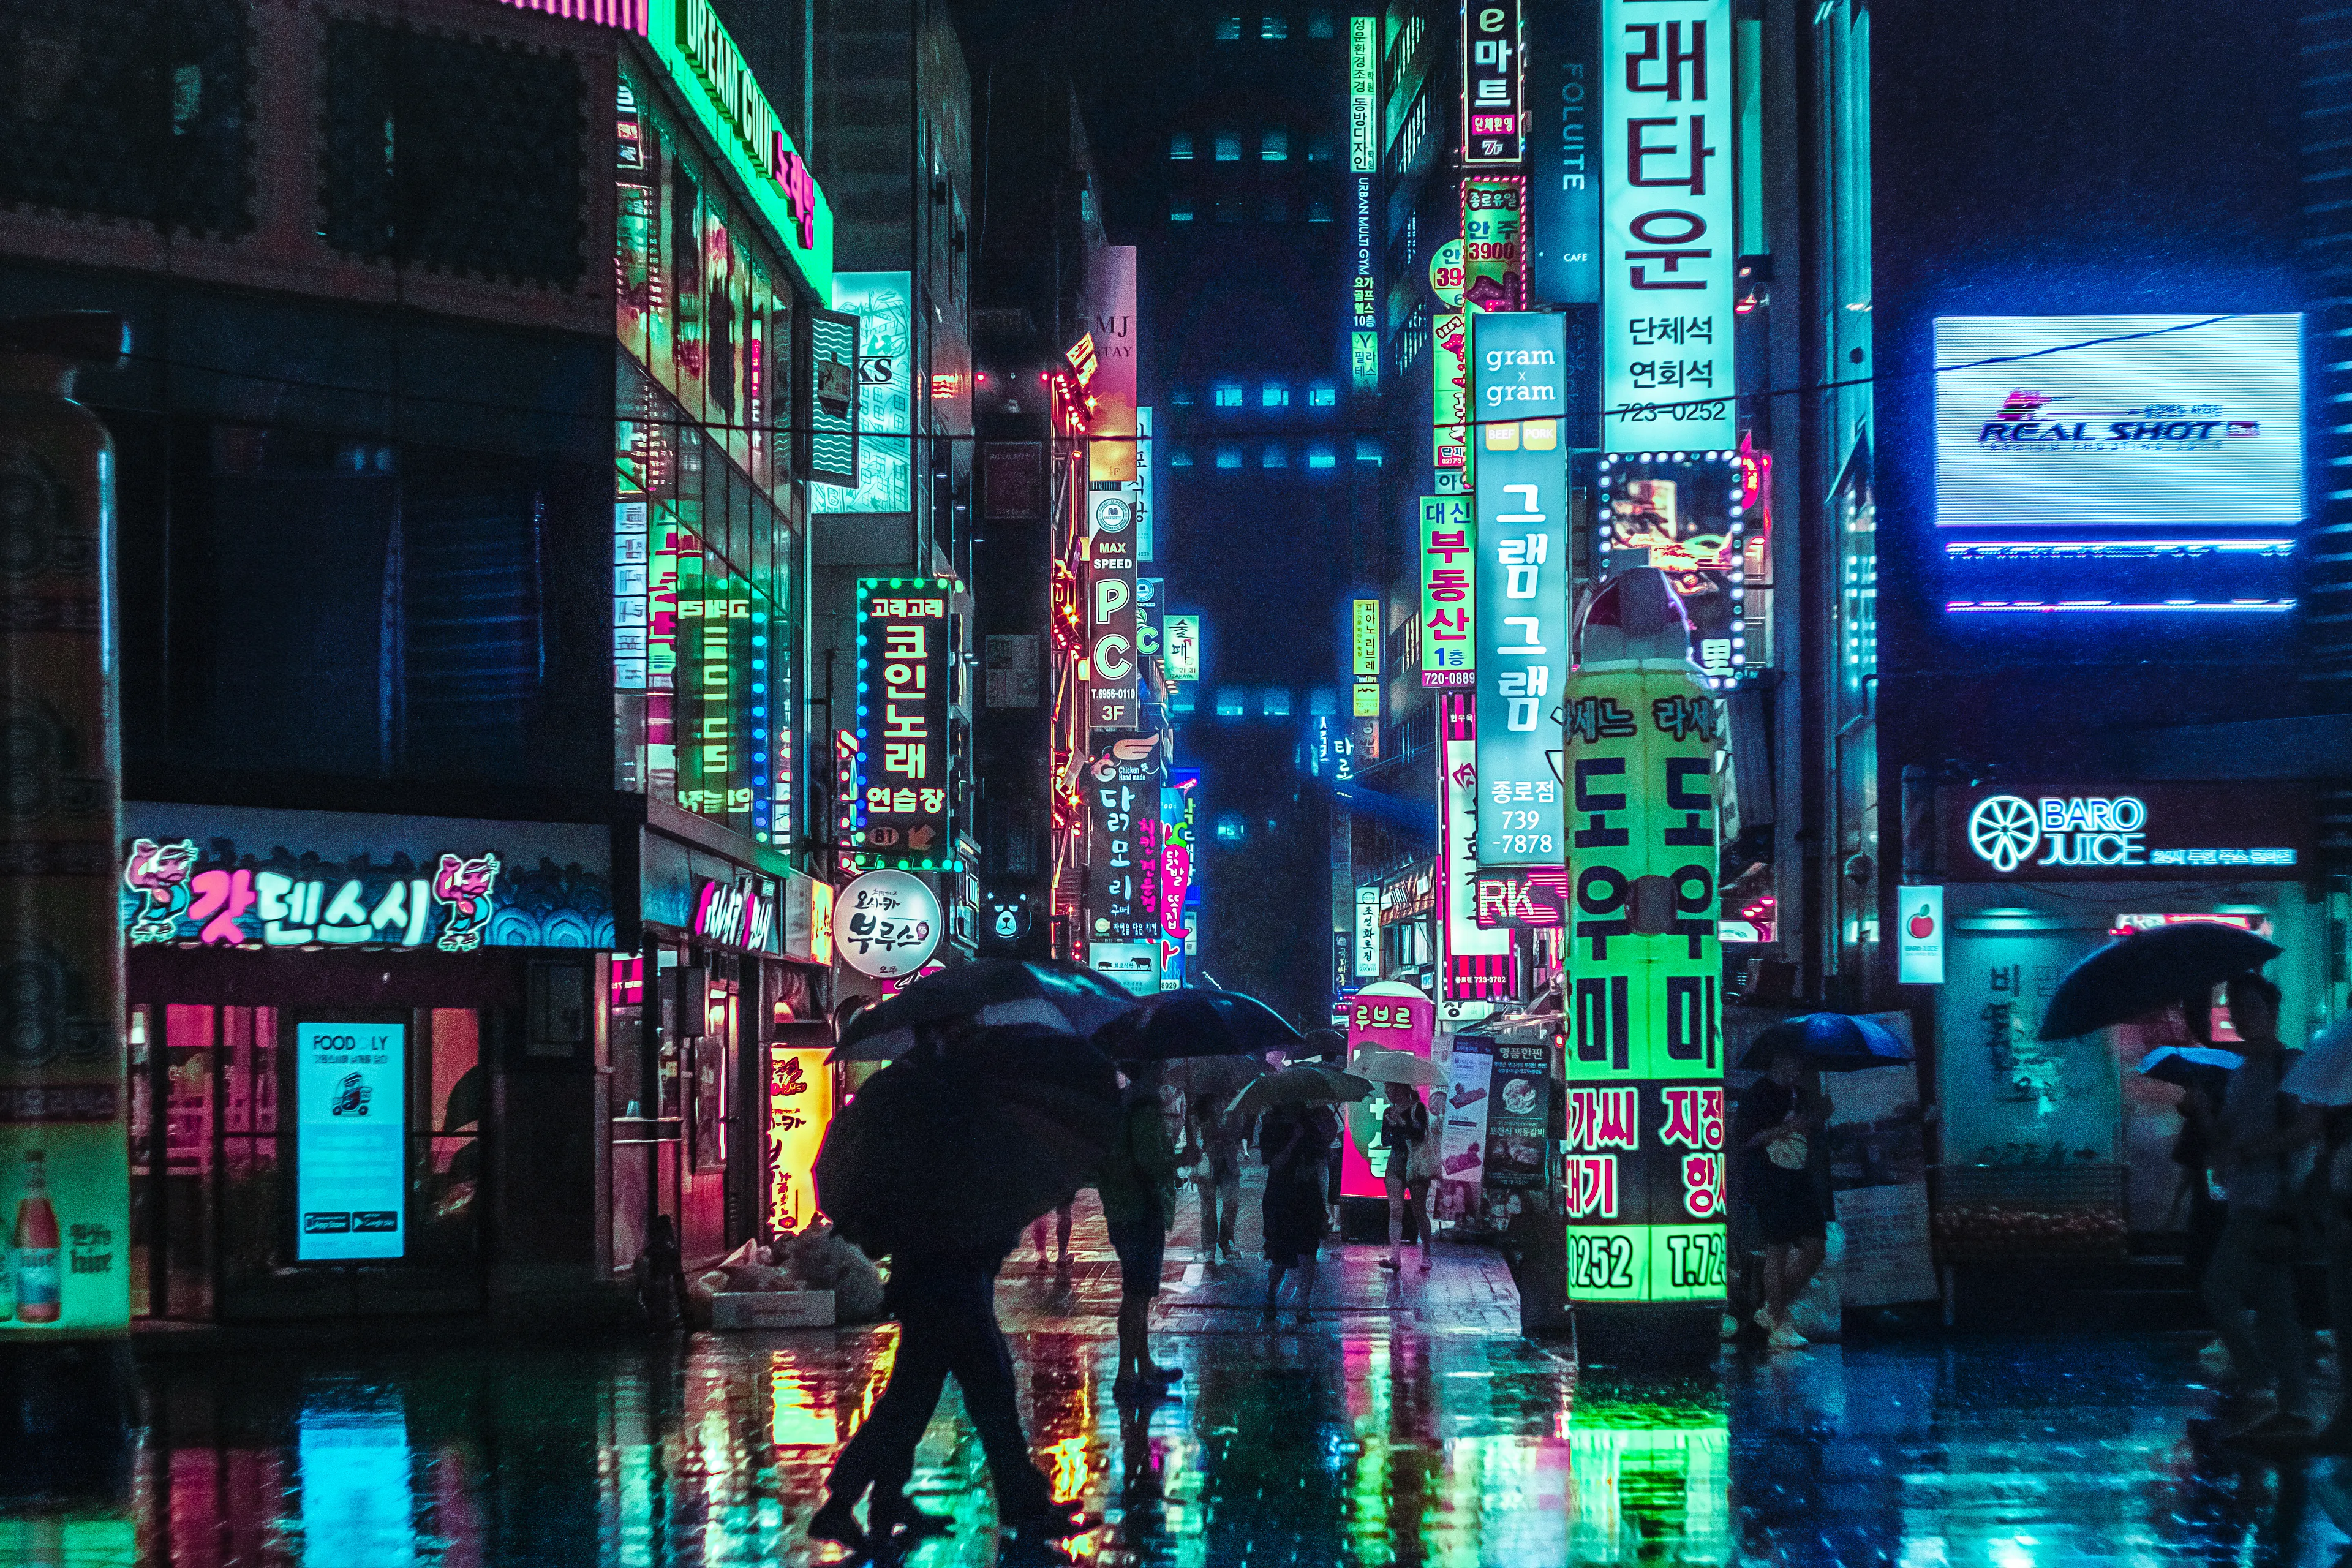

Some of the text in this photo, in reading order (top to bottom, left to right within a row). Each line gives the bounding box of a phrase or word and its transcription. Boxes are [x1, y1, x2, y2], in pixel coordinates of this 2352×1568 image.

[742, 69, 772, 179] COIN
[1353, 97, 1368, 170] 동방디자인
[1474, 116, 1513, 133] 단체환영
[1482, 140, 1503, 156] 7F
[1622, 0, 1716, 290] 래타운
[1358, 177, 1370, 275] URBAN MULTI GYM
[1468, 242, 1515, 260] 3900
[1564, 253, 1587, 262] CAFE
[1354, 276, 1374, 289] 요가
[1095, 315, 1130, 337] MJ
[1353, 315, 1376, 328] 10층
[1629, 316, 1713, 347] 단체석
[1094, 346, 1132, 357] STAY
[1485, 349, 1555, 371] gram
[1629, 358, 1713, 389] 연회석
[1486, 384, 1556, 407] gram
[1618, 401, 1727, 423] 723-0252
[1488, 427, 1555, 441] BEEF PORK
[1980, 421, 2218, 442] REAL SHOT
[1099, 543, 1126, 554] MAX
[1093, 559, 1133, 570] SPEED
[1427, 530, 1470, 641] 부동산
[871, 598, 944, 618] 고래고래
[1496, 484, 1548, 731] 그램그램
[1433, 647, 1465, 666] 1층
[1424, 671, 1475, 685] 720-0889
[884, 625, 928, 779] 코인노래
[1091, 688, 1136, 700] T.6956-0110
[1102, 705, 1124, 721] 3F
[1333, 737, 1354, 781] 타로
[866, 787, 945, 813] 연습장
[1491, 780, 1555, 804] 종로점
[1502, 810, 1540, 831] 739
[2040, 796, 2146, 832] BARO
[875, 828, 893, 843] B1
[1493, 834, 1553, 854] -7878
[2038, 832, 2146, 866] JUICE
[1479, 880, 1534, 918] RK
[1574, 757, 1630, 1070] 도우미
[1664, 756, 1716, 1069] 도우미
[848, 913, 921, 955] 부루스
[1362, 907, 1375, 962] 조선화로집
[1355, 1005, 1412, 1031] 루브르
[1499, 1047, 1544, 1060] 명품한판
